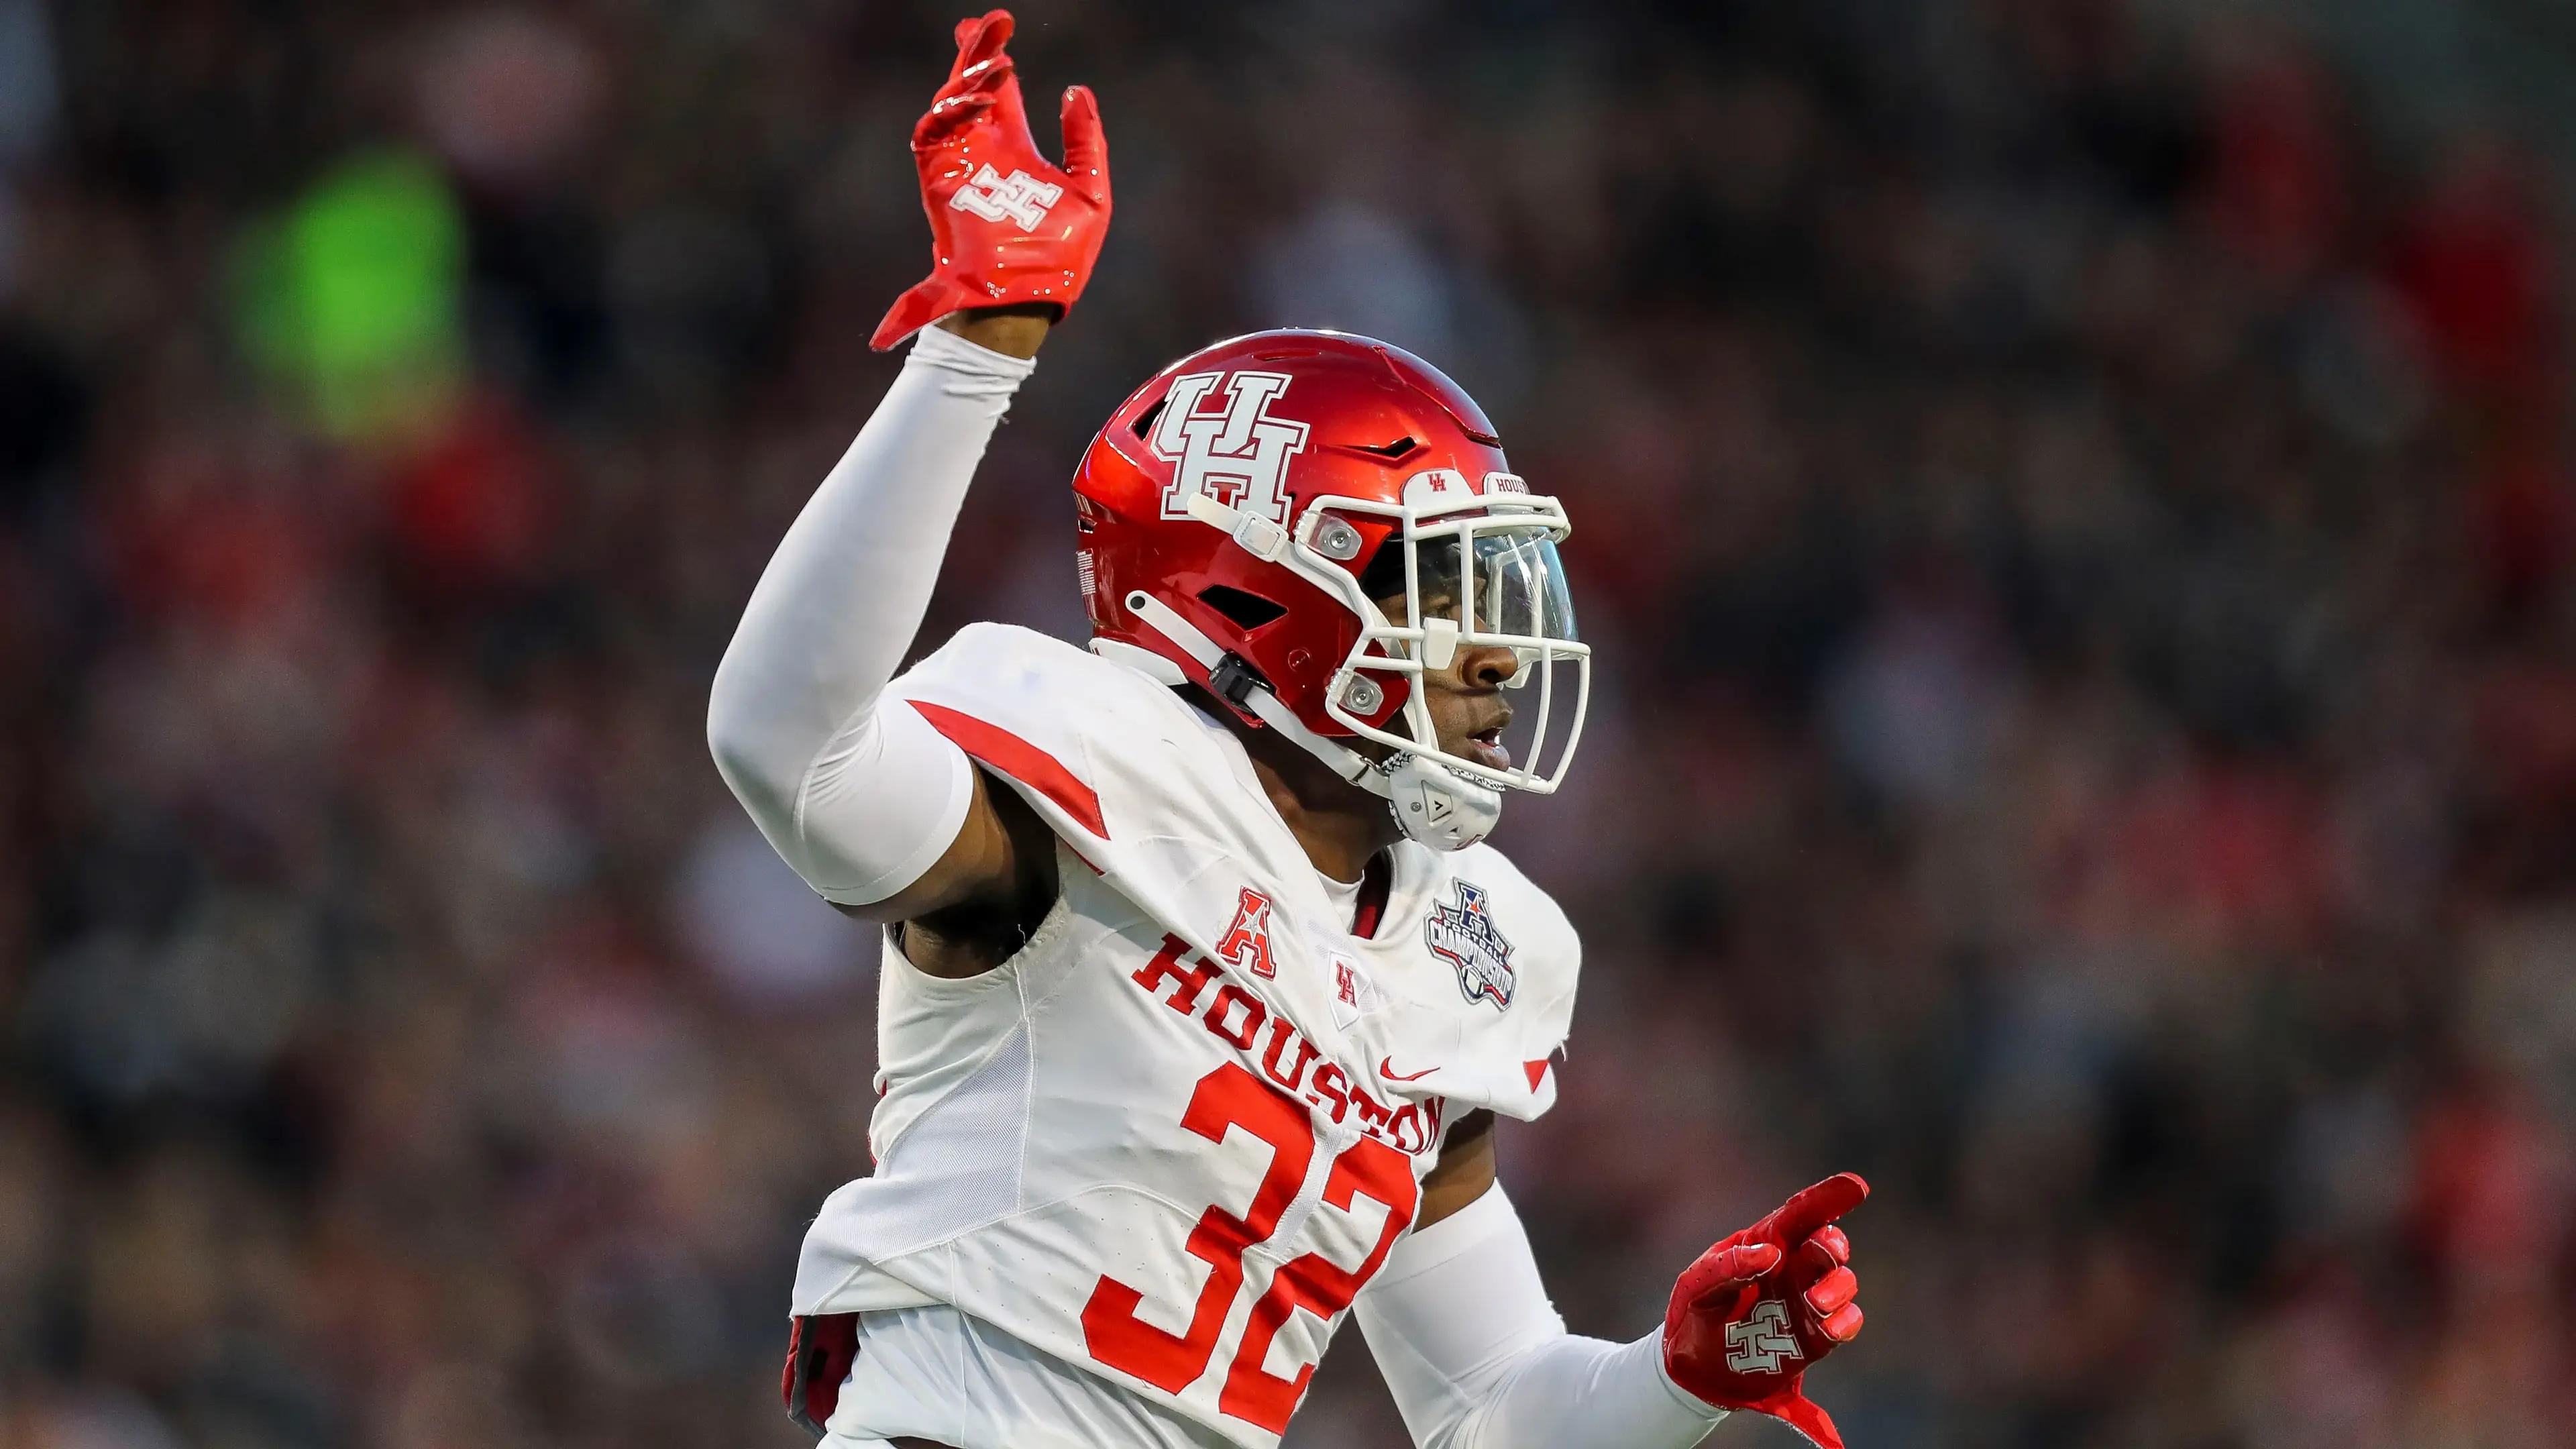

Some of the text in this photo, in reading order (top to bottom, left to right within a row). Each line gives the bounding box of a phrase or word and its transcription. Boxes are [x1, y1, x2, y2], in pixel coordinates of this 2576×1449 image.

[1430, 920, 1513, 999] CHAMPIONSHIP
[1444, 919, 1504, 965] FOOTBALL
[1131, 932, 1446, 1156] HOUSTON
[1081, 1061, 1417, 1437] 32
